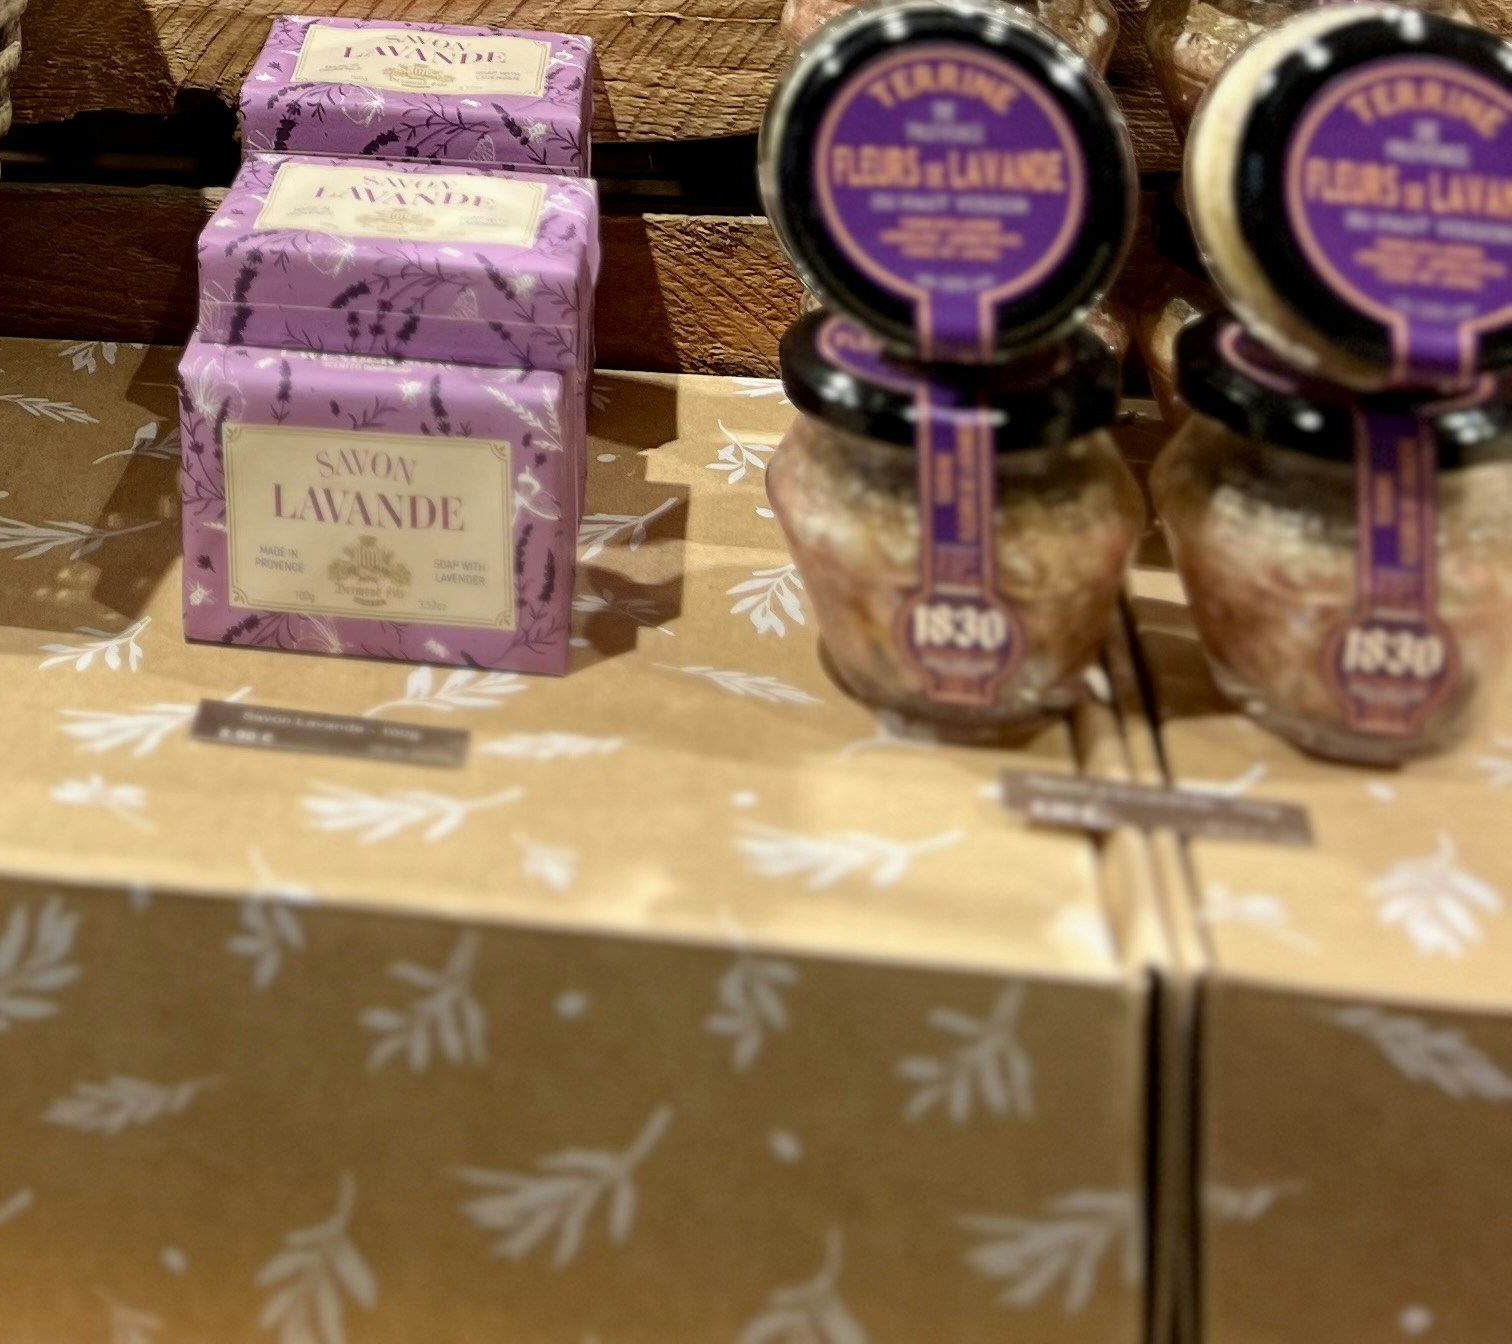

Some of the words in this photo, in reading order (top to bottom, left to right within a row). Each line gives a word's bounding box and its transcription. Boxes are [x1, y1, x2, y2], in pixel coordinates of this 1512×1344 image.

[385, 34, 473, 52] SAVON
[344, 45, 507, 65] LAVANDE
[363, 176, 455, 191] SAVON
[314, 185, 496, 210] LAVANDE
[315, 447, 417, 487] SAVON
[273, 482, 466, 533] LAVANDE
[259, 543, 286, 558] MADE
[255, 557, 305, 574] PROVENCE
[433, 558, 459, 571] SOAP
[461, 561, 487, 573] WITH
[434, 571, 487, 586] LAVENDER
[913, 602, 1007, 651] 1830
[1341, 626, 1445, 680] 1830
[242, 710, 292, 725] Savon
[296, 716, 365, 734] Lavande
